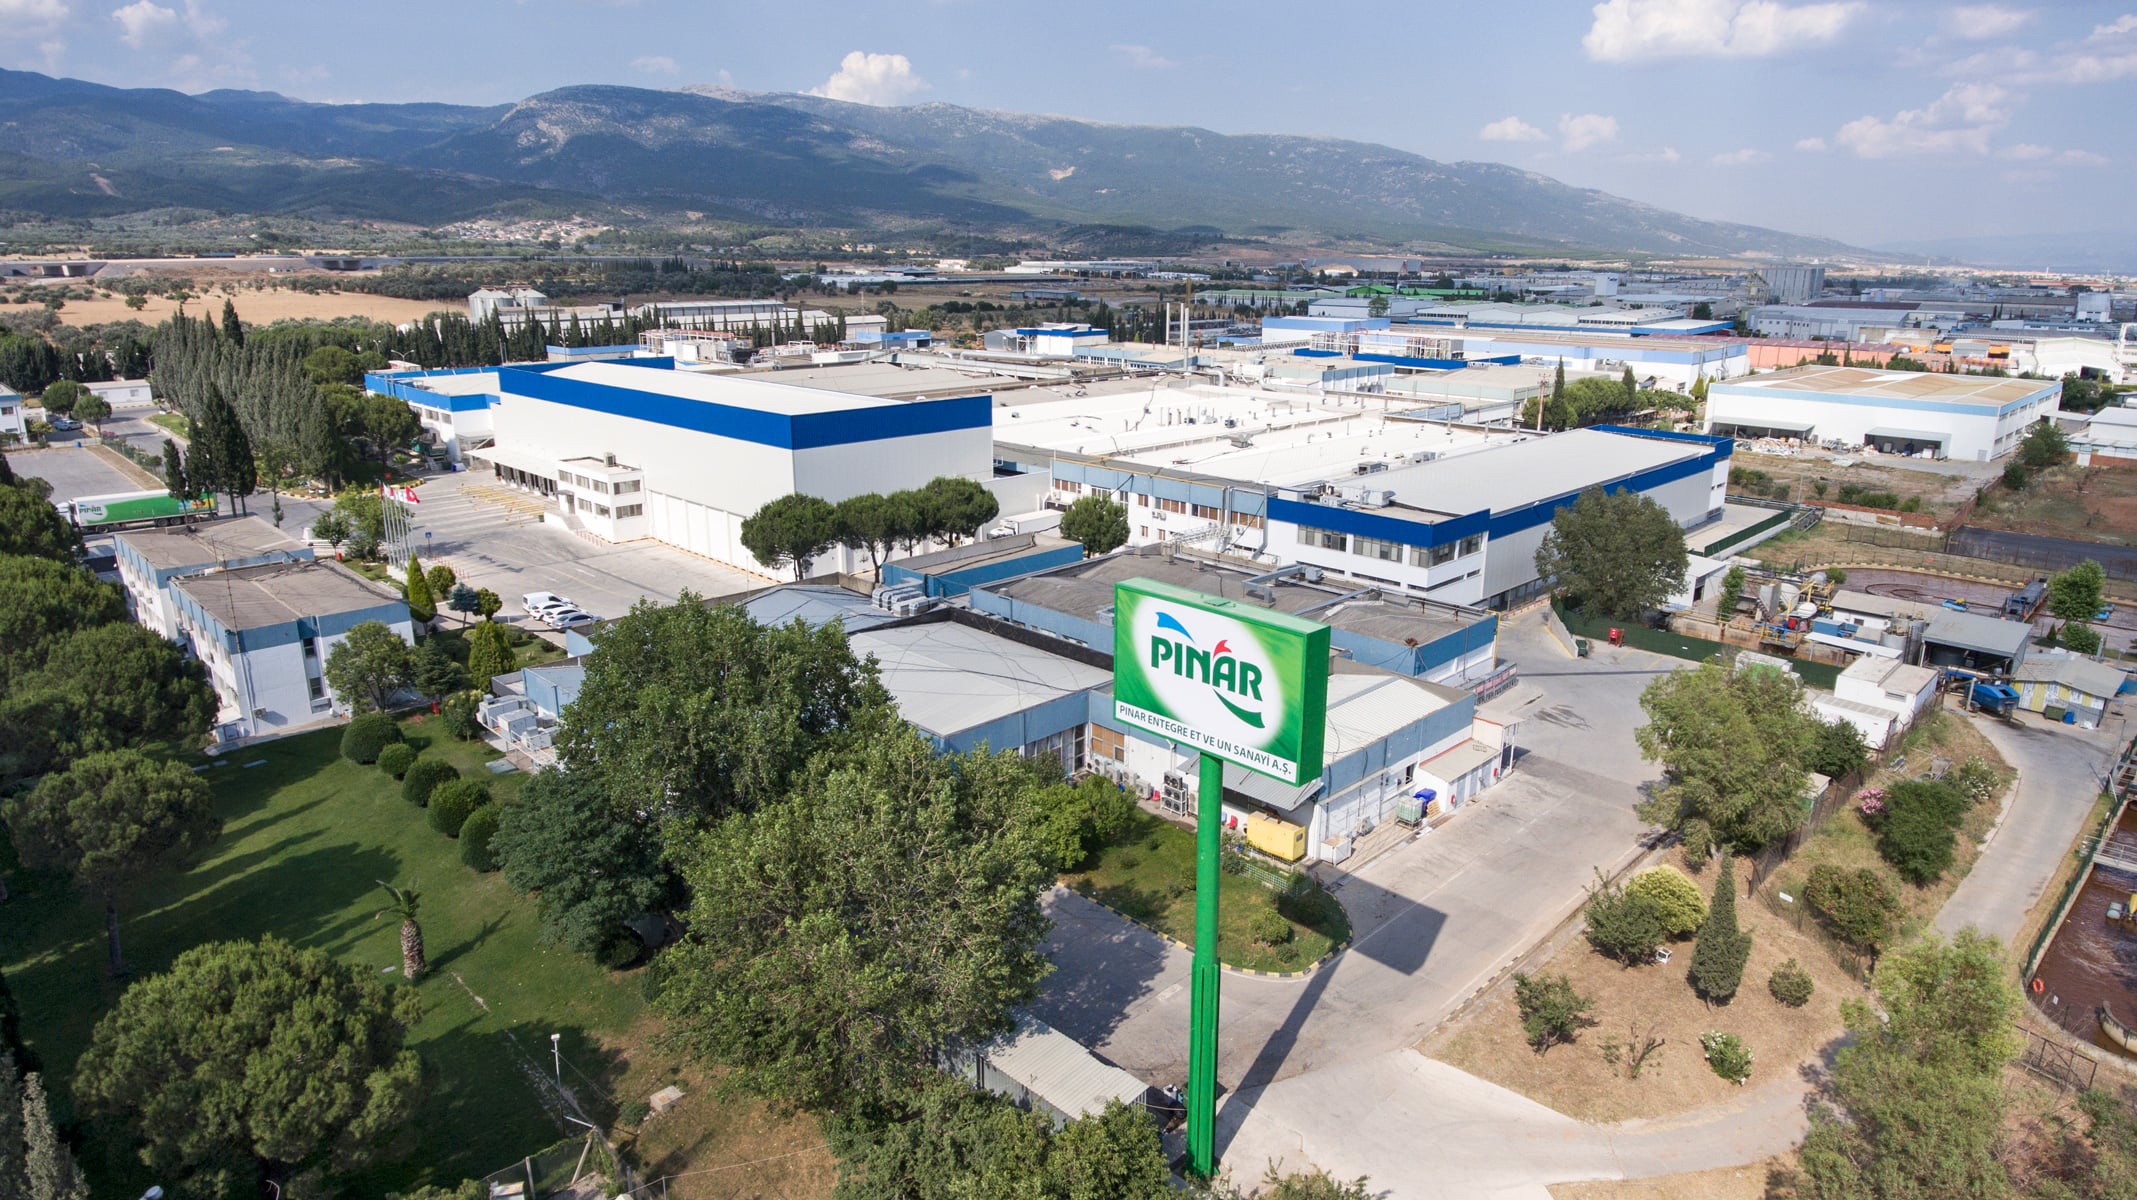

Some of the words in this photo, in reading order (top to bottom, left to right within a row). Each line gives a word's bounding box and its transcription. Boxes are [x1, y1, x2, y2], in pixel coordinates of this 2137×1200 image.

[1151, 635, 1263, 702] PINAR
[1119, 704, 1146, 723] PINAR
[1147, 715, 1188, 737] ENTEGRE
[1190, 729, 1201, 742] ET
[1202, 733, 1215, 747] VE
[1216, 738, 1232, 753] UN
[1233, 745, 1270, 766] SANAYİ
[1271, 760, 1292, 775] A.Ş.
